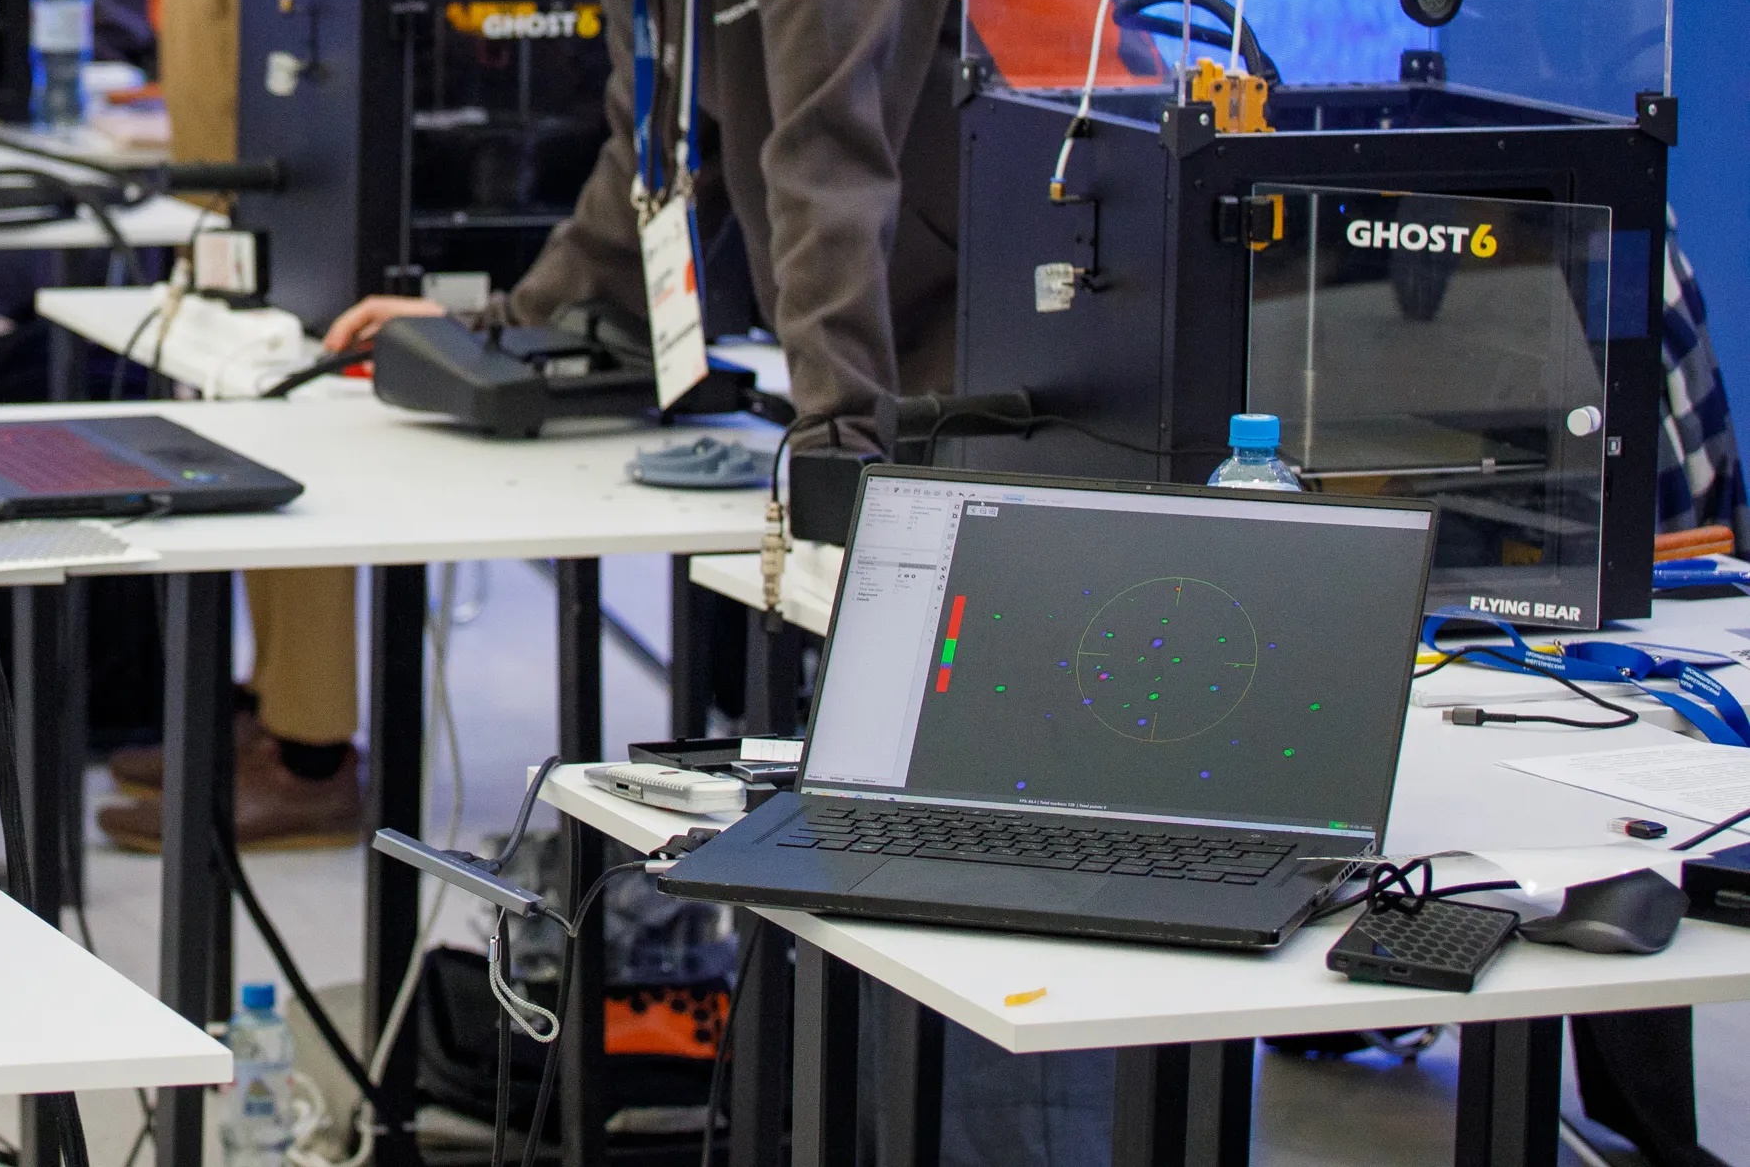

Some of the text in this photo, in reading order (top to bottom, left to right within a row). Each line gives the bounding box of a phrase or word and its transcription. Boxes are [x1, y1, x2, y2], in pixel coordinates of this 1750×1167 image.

[1346, 219, 1498, 258] GHOST6
[1470, 596, 1581, 622] FLYING BEAR
